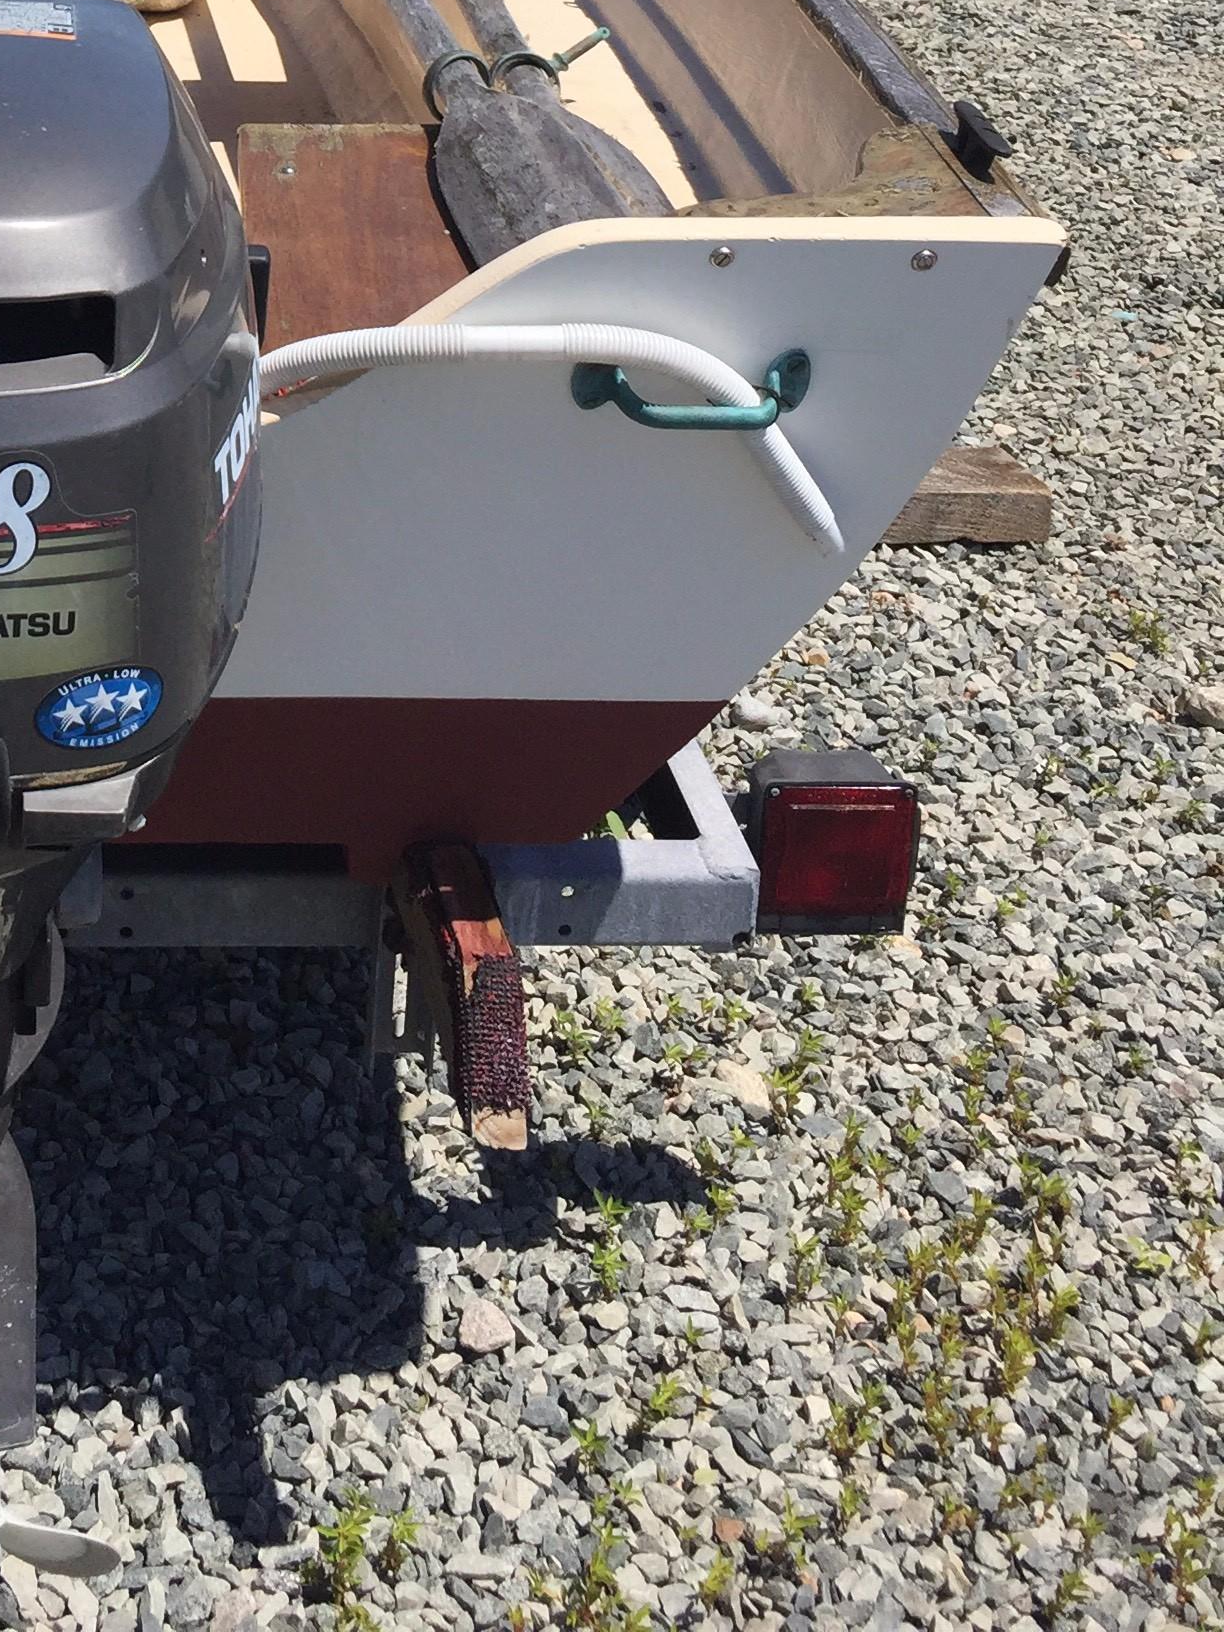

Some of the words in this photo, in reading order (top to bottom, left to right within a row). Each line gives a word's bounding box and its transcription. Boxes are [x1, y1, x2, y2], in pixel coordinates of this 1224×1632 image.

[57, 673, 102, 696] ULTRA
[113, 669, 141, 679] LOW
[69, 722, 140, 748] EMISSION
